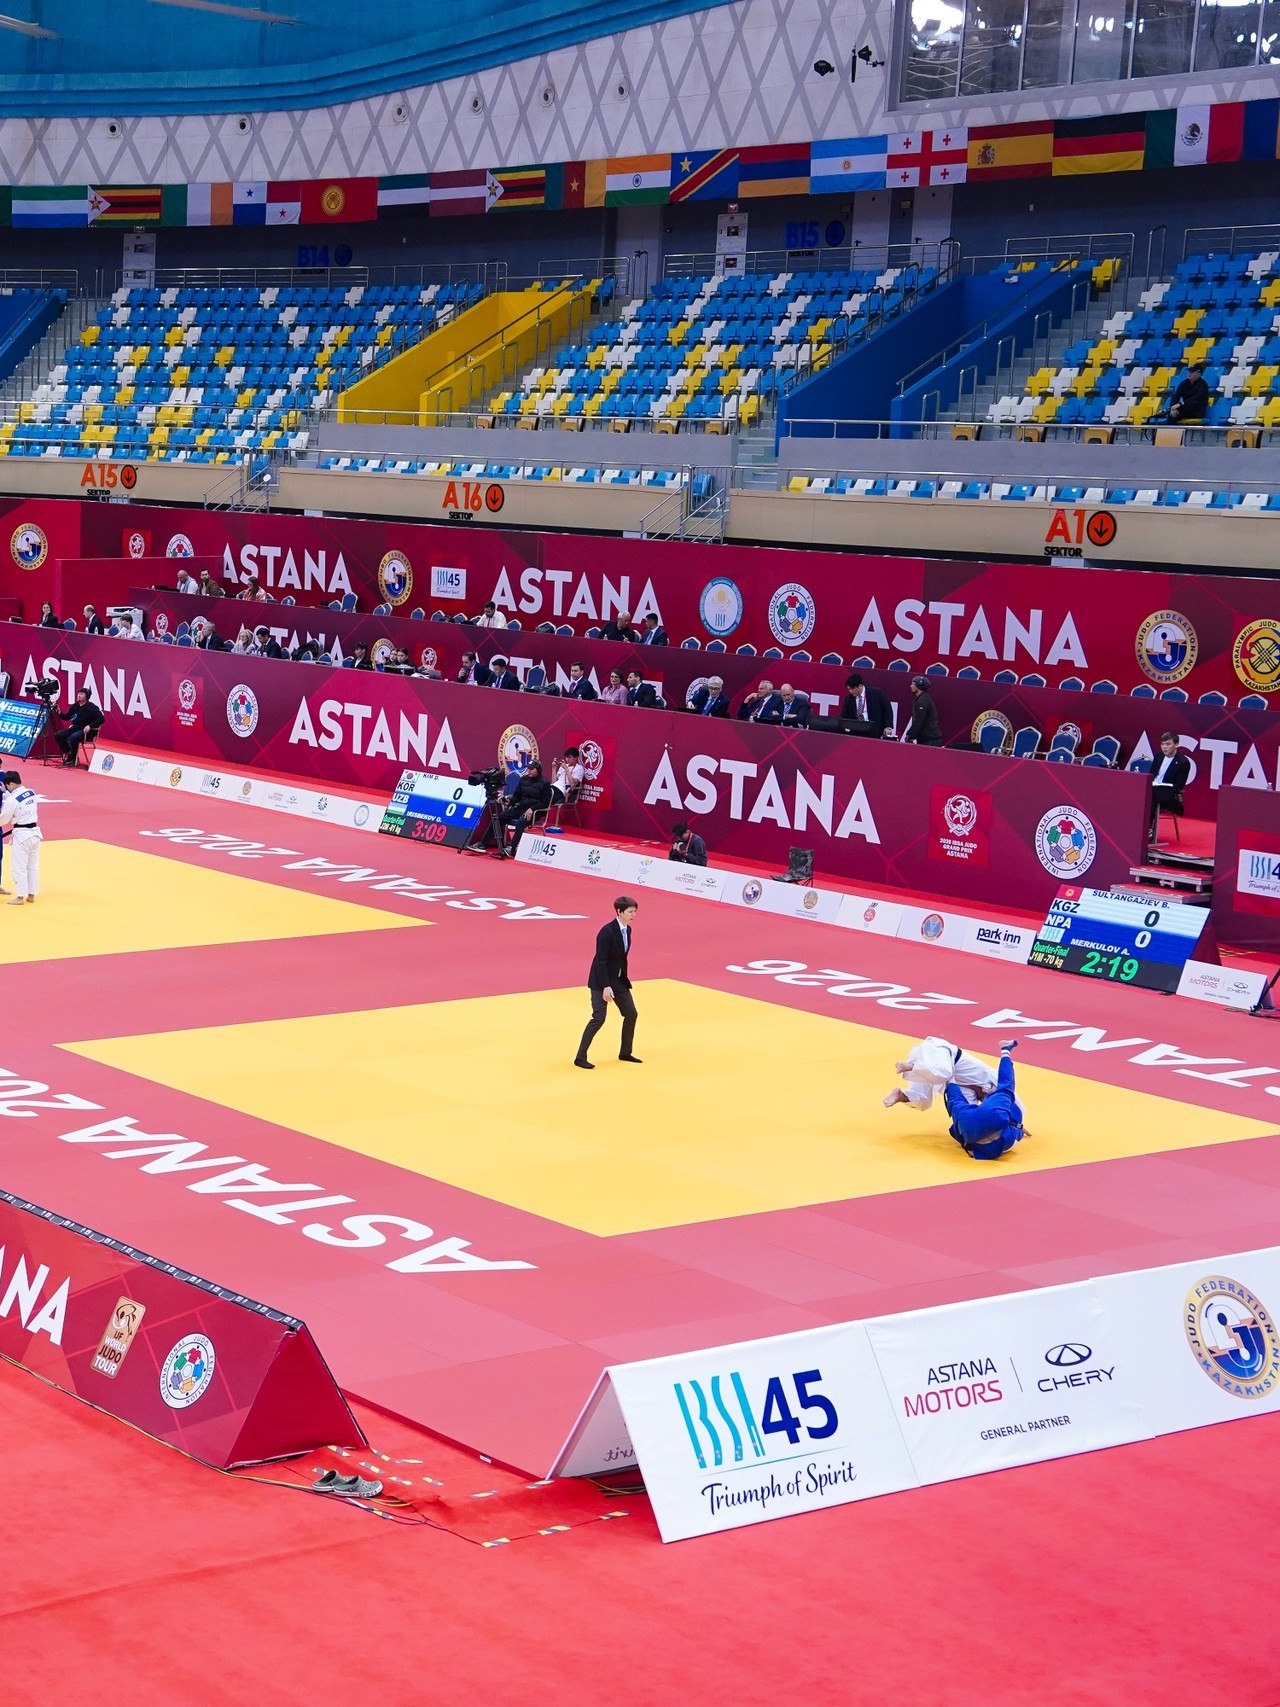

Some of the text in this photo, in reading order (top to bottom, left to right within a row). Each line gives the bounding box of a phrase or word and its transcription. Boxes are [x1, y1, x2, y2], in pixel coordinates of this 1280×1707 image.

[786, 221, 819, 248] B15
[80, 463, 118, 488] A15
[442, 481, 483, 511] A16
[1044, 546, 1083, 557] SEKTOR
[223, 542, 353, 593] ASTANA
[448, 572, 460, 587] 45
[491, 565, 664, 626] ASTANA
[851, 596, 1089, 669] ASTANA
[1138, 612, 1196, 652] JUDO FEDERATION
[1235, 621, 1278, 669] PARALYMPIC JUDO
[1137, 653, 1194, 683] KAZAKHSTAN
[20, 654, 152, 719] ASTANA
[289, 696, 461, 772] ASTANA
[392, 793, 457, 817] UZB 0
[397, 782, 463, 801] KOR 0
[644, 749, 881, 844] ASTANA
[411, 820, 447, 842] 3:09
[1037, 807, 1095, 876] INTERNATIONAL JUDO FEDERATION
[542, 843, 557, 857] 45
[139, 827, 590, 921] 2026 ASTANA
[1051, 899, 1160, 928] KGZ 0
[1092, 890, 1170, 909] SULTANGAZIEV B.
[976, 926, 1021, 944] park inn
[1044, 914, 1151, 948] NPA 0
[1033, 941, 1070, 957] Quarter-Final
[1043, 953, 1054, 965] -70
[1054, 955, 1064, 968] kg
[1070, 938, 1130, 956] MERKULOV A.
[1080, 951, 1139, 981] 2:19
[726, 958, 979, 1011] 2026
[1189, 978, 1218, 989] MOTORS
[57, 1115, 539, 1273] ASTANA
[1186, 1279, 1274, 1348] JUDO FEDERATION
[103, 1335, 127, 1351] WORLD
[113, 1330, 125, 1340] IJF
[93, 1355, 118, 1376] TOUR
[97, 1346, 122, 1364] JUDO
[160, 1339, 187, 1402] INTERNATIONAL
[193, 1335, 210, 1346] JUDO
[926, 1357, 998, 1386] ASTANA
[1037, 1366, 1116, 1393] CHERY
[1201, 1348, 1280, 1397] KAZAKHSTAN
[761, 1369, 840, 1447] 45
[903, 1379, 1003, 1418] MOTORS
[980, 1415, 1072, 1441] GENERAL PARTNER
[701, 1460, 858, 1516] Triumph of Spirit
